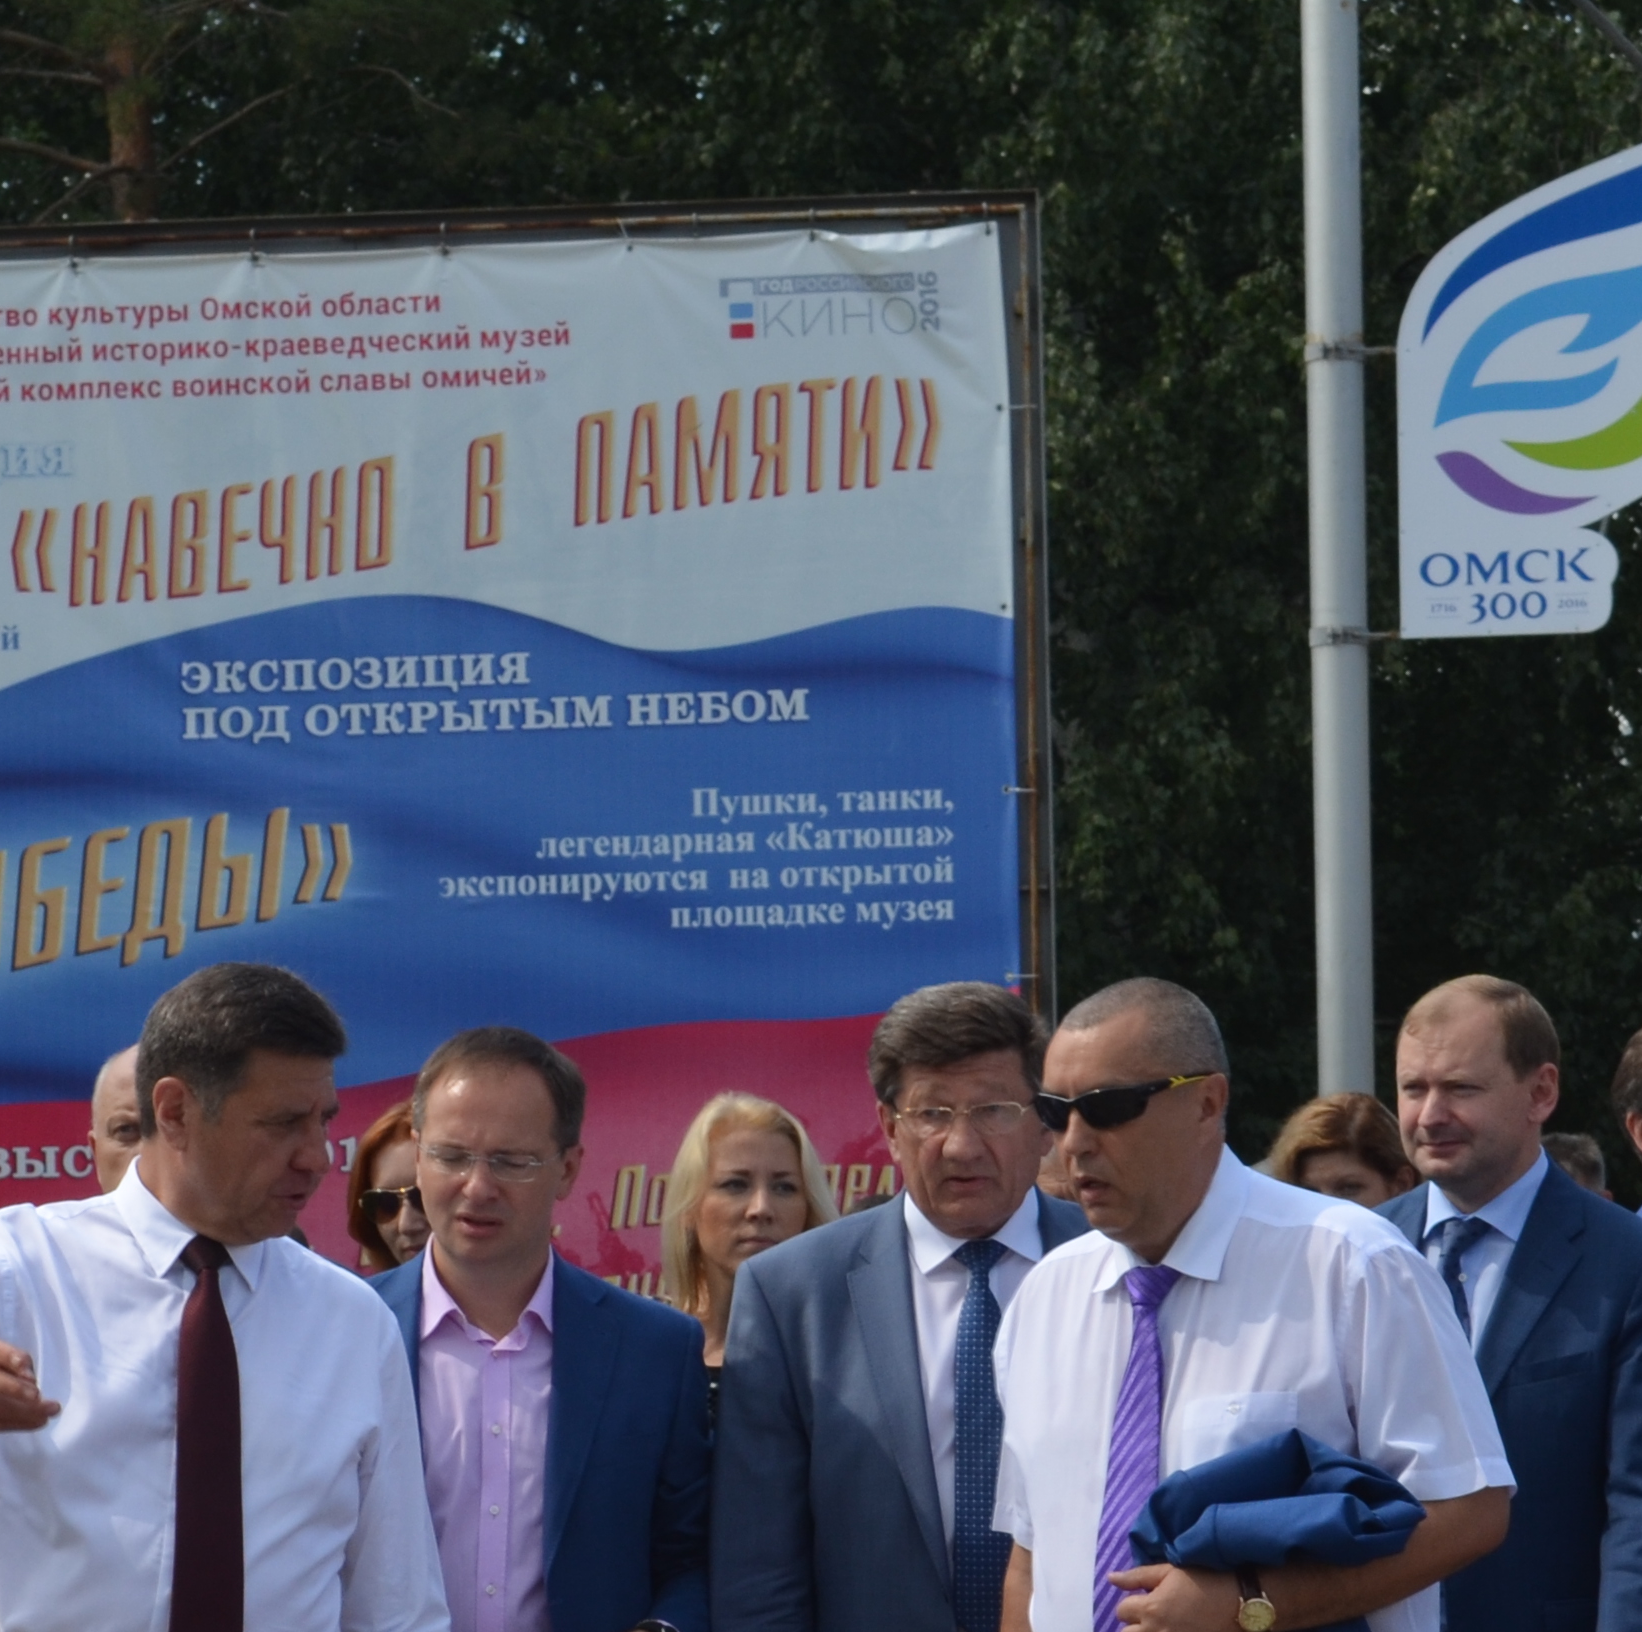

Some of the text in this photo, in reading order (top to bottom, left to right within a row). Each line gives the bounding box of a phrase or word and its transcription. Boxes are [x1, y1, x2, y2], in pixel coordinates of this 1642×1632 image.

[48, 302, 188, 329] культуры
[200, 293, 312, 321] Омской
[322, 291, 441, 318] области
[762, 296, 917, 338] КИНО
[917, 270, 940, 331] 2016
[92, 325, 470, 365] историко-краеведческий
[480, 321, 571, 353] музей
[20, 379, 162, 403] комплекс
[173, 369, 311, 398] воинской
[319, 368, 411, 393] славы
[422, 360, 547, 388] омичей»
[10, 374, 942, 607] «НАВЕЧНО В ПАМЯТИ»
[1420, 547, 1595, 587] ОМСК
[1468, 591, 1547, 624] 300
[180, 652, 531, 694] ЭКСПОЗИЦИЯ
[182, 688, 810, 743] ПОД ОТКРЫТЫМ НЕБОМ
[691, 787, 955, 823] Пушки, танки,
[536, 822, 954, 861] легендарная «Катюша»
[438, 856, 955, 901] экспонируются на открытой
[670, 899, 955, 929] площадке музея
